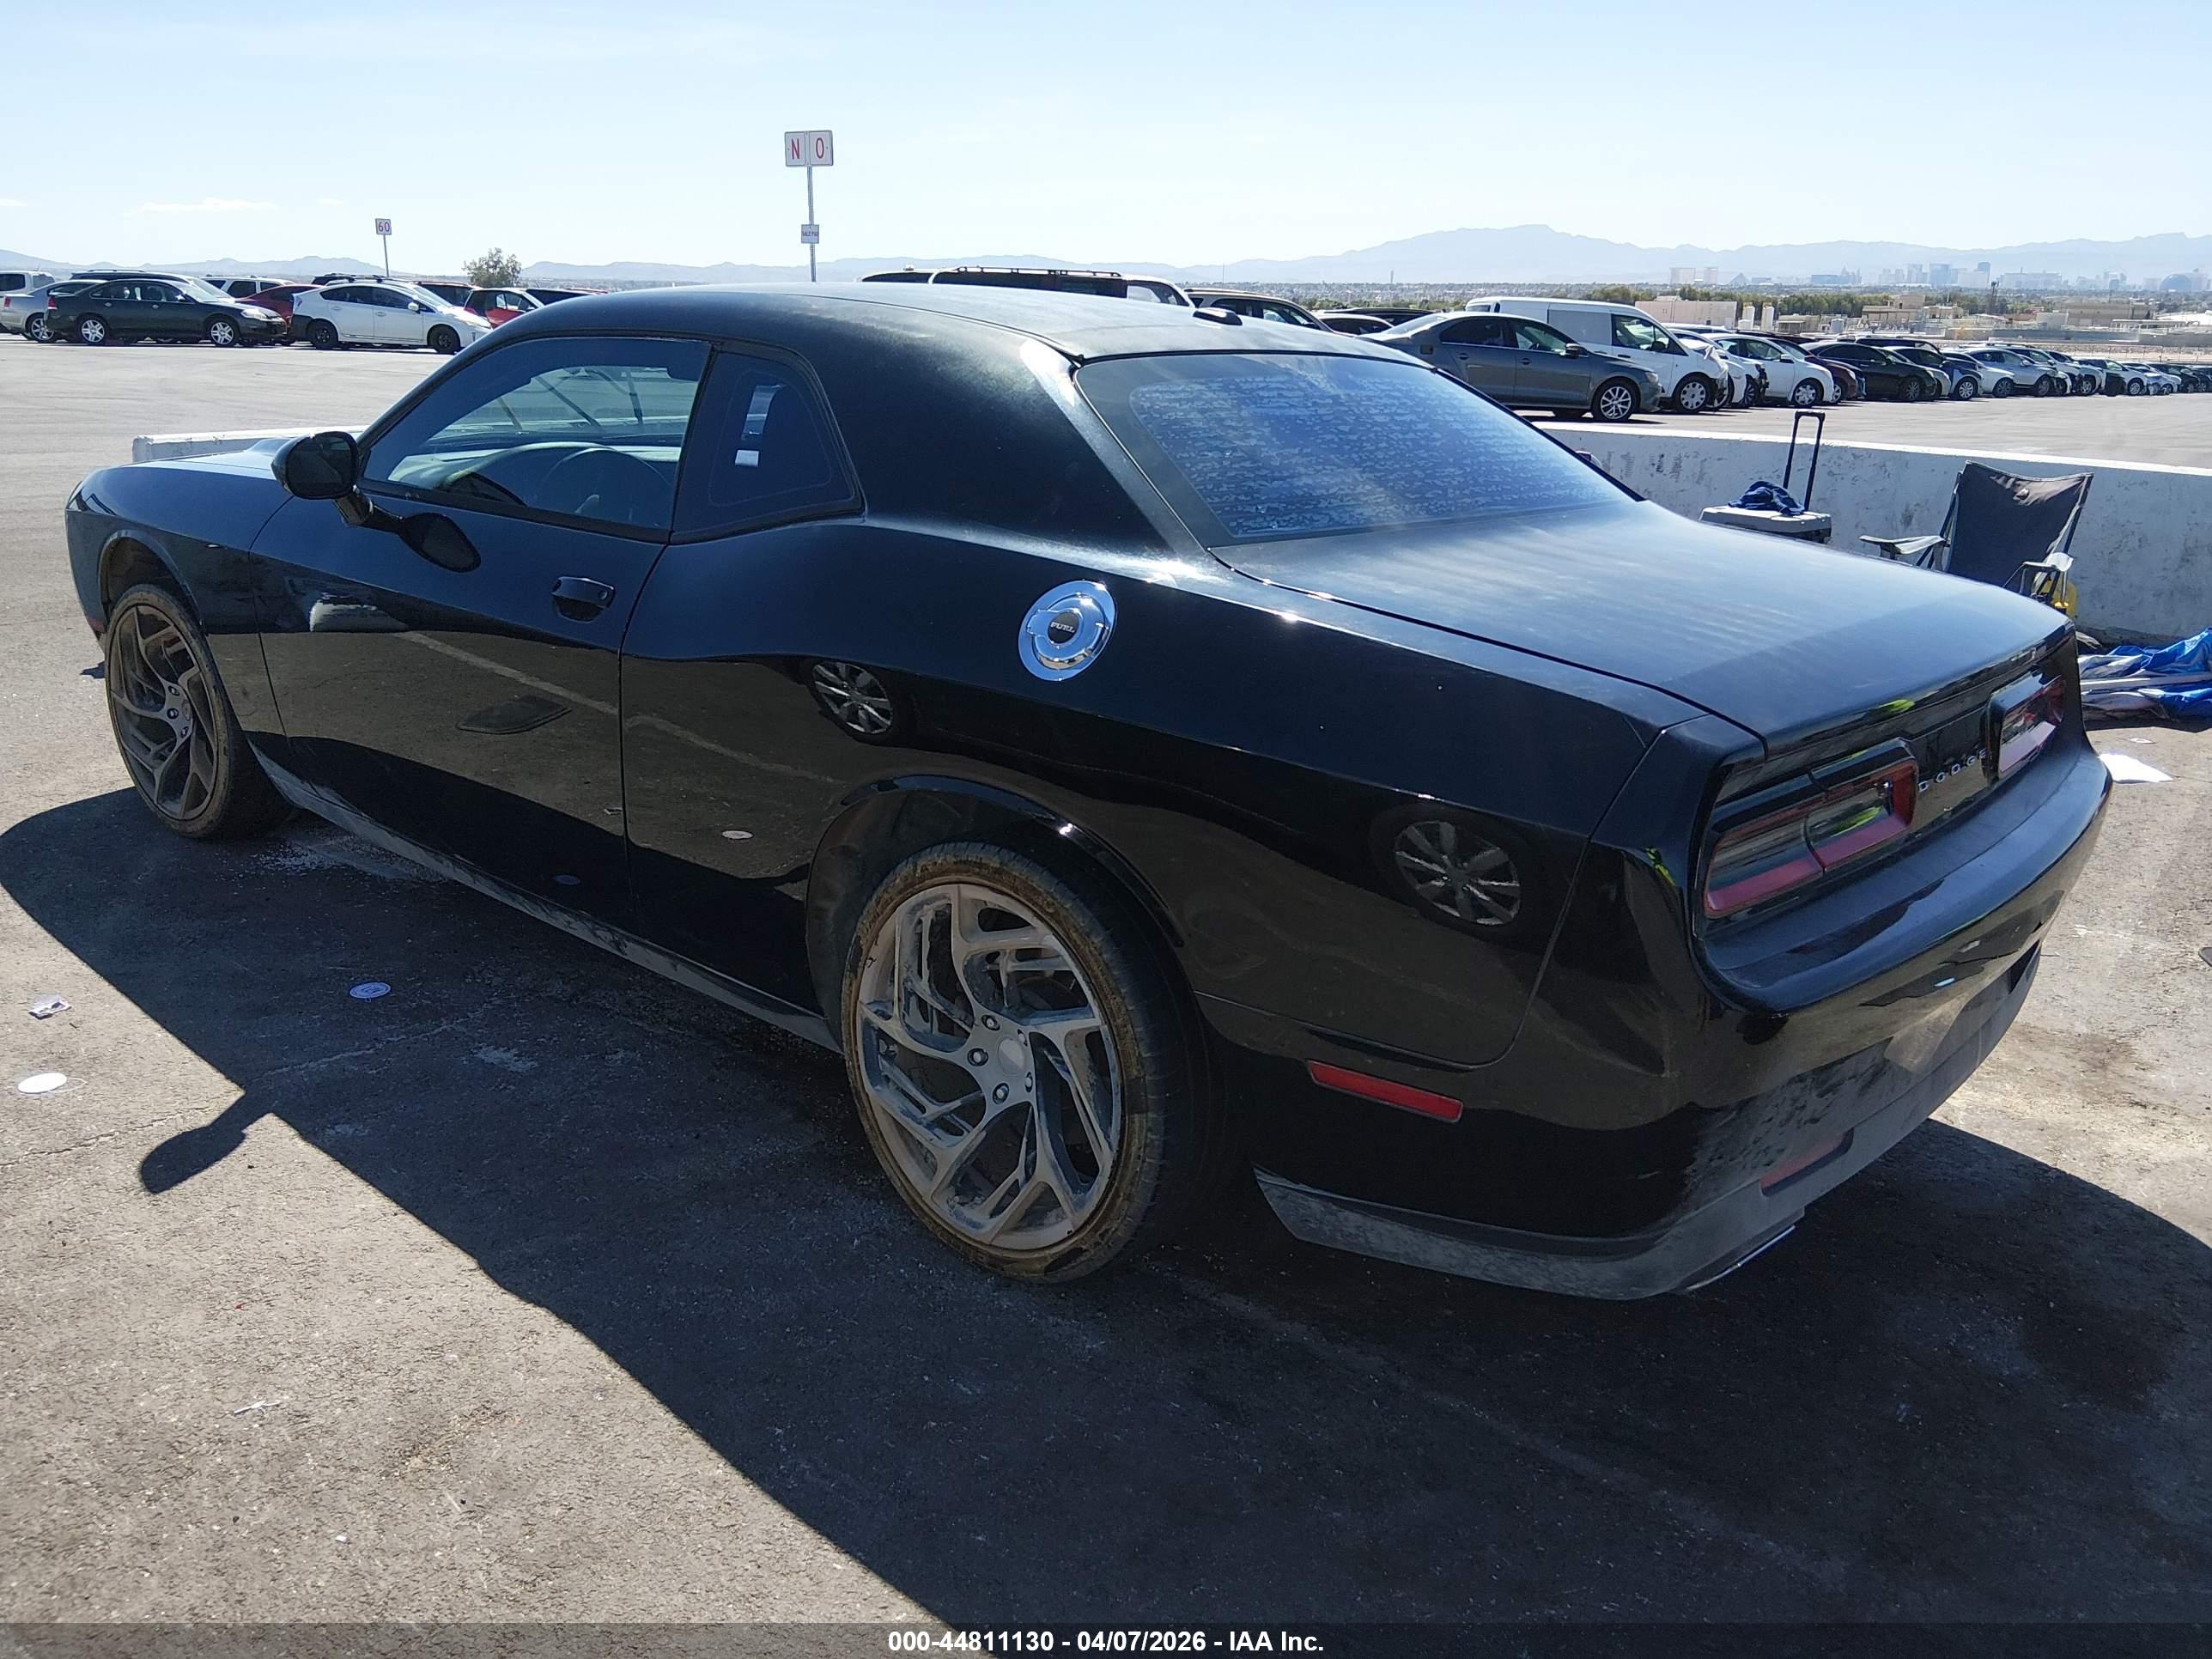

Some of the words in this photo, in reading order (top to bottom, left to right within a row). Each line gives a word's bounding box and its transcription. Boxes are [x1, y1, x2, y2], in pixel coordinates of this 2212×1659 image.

[378, 222, 390, 232] 60
[1050, 622, 1075, 633] FUEL
[1918, 748, 1987, 793] DODGE
